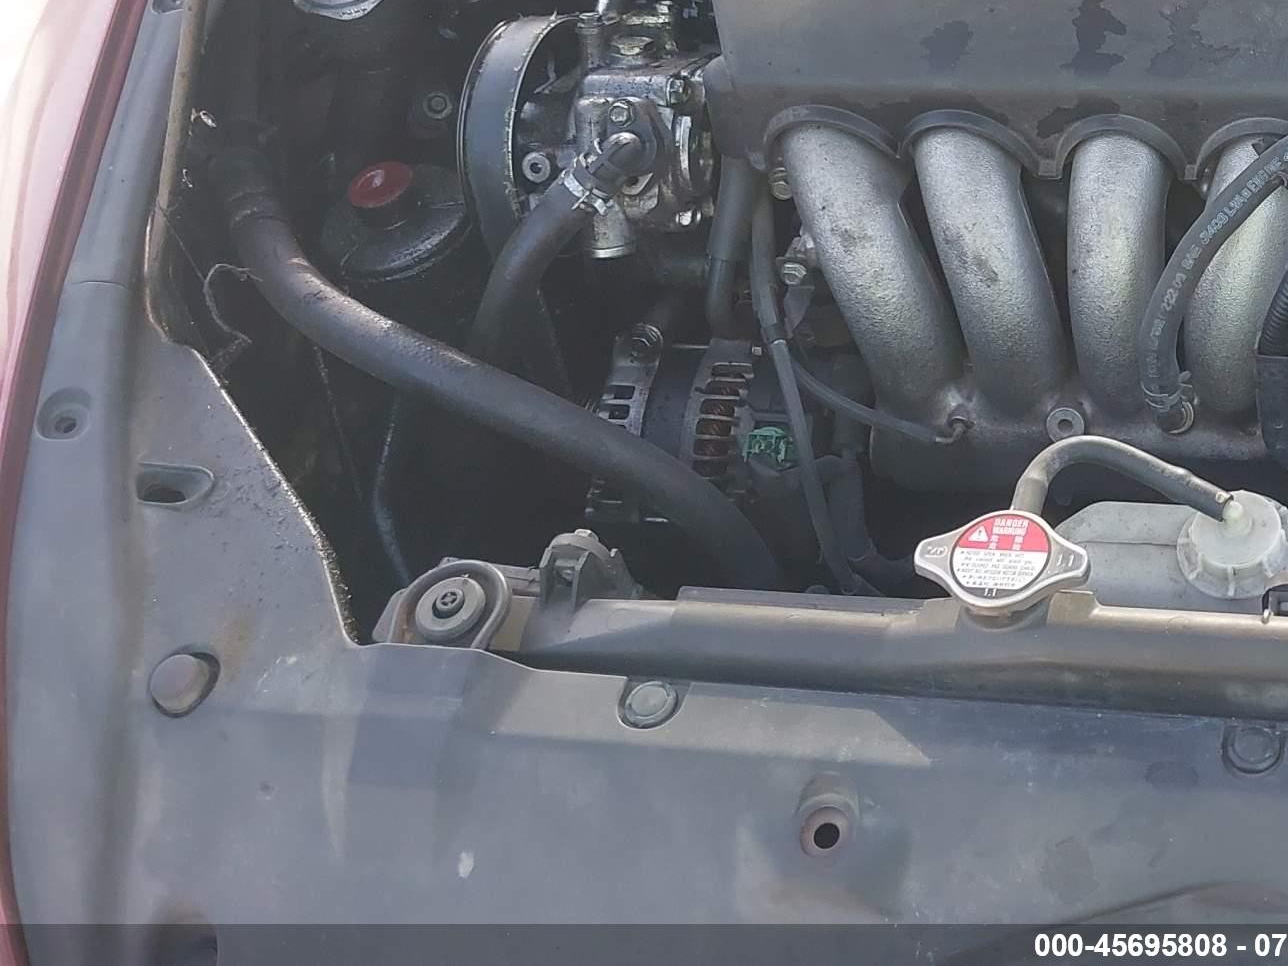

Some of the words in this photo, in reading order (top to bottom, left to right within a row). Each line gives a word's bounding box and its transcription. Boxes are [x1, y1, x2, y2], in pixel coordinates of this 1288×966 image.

[994, 518, 1029, 528] DANGER
[1056, 553, 1075, 567] 1.1
[984, 588, 997, 597] 1.1
